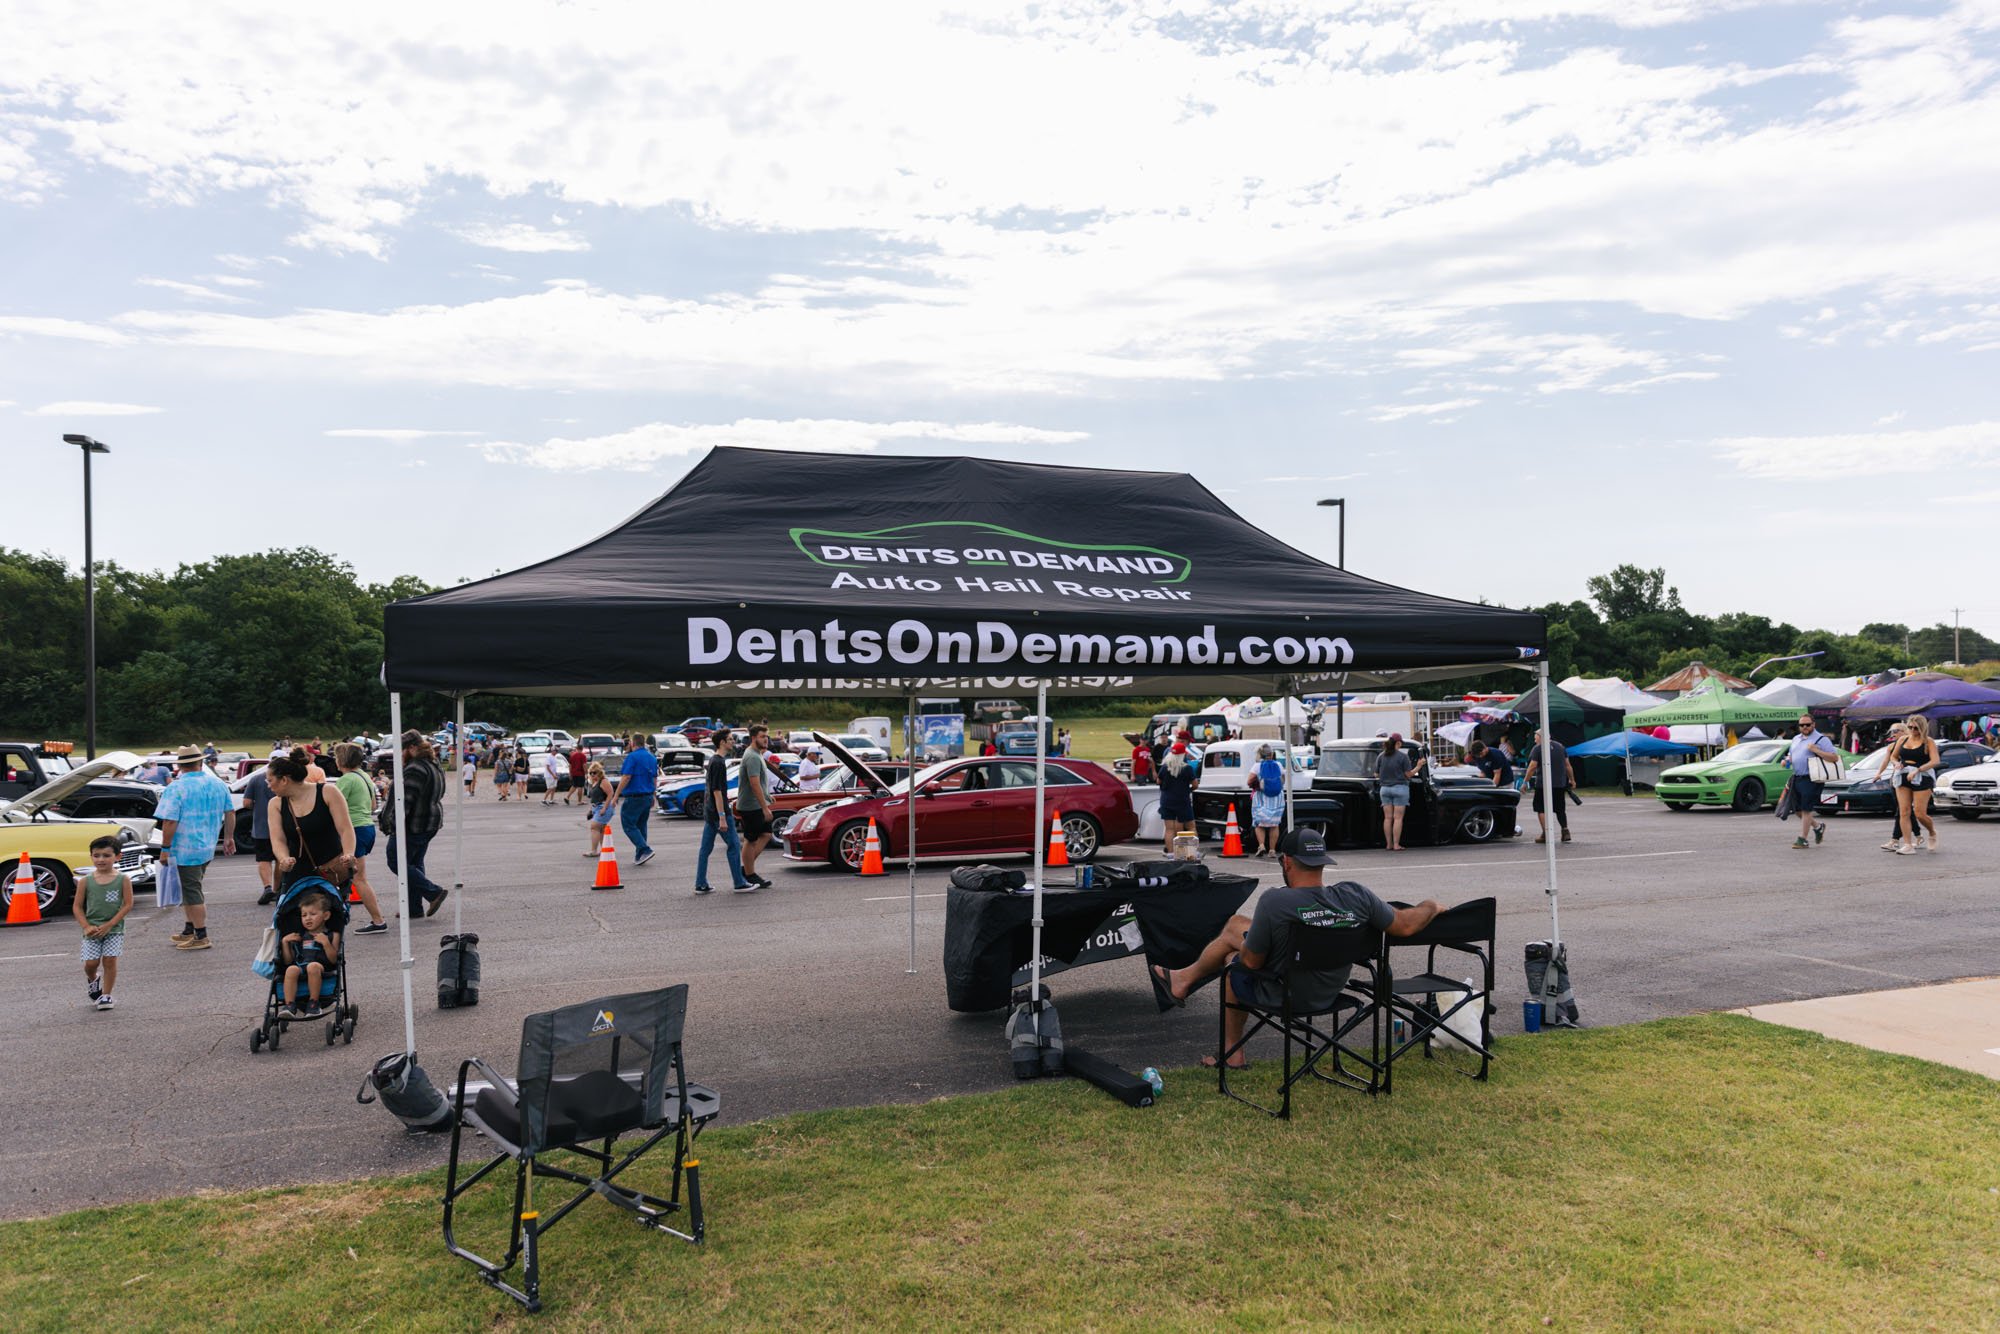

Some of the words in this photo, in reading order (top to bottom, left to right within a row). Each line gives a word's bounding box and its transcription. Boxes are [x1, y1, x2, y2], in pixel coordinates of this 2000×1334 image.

[820, 545, 957, 565] DENTS
[963, 547, 1006, 561] on
[1013, 550, 1174, 575] DEMAND
[830, 572, 942, 592] Auto
[955, 576, 1044, 594] Hail
[1052, 580, 1192, 602] Repair
[687, 617, 1354, 665] DentsOnDemand.com
[1635, 716, 1665, 724] RENEWAL
[1673, 713, 1709, 721] ANDERSEN
[1735, 712, 1763, 720] RENEWAL
[1769, 711, 1798, 719] ANDERSEN
[1302, 910, 1324, 919] DENTS
